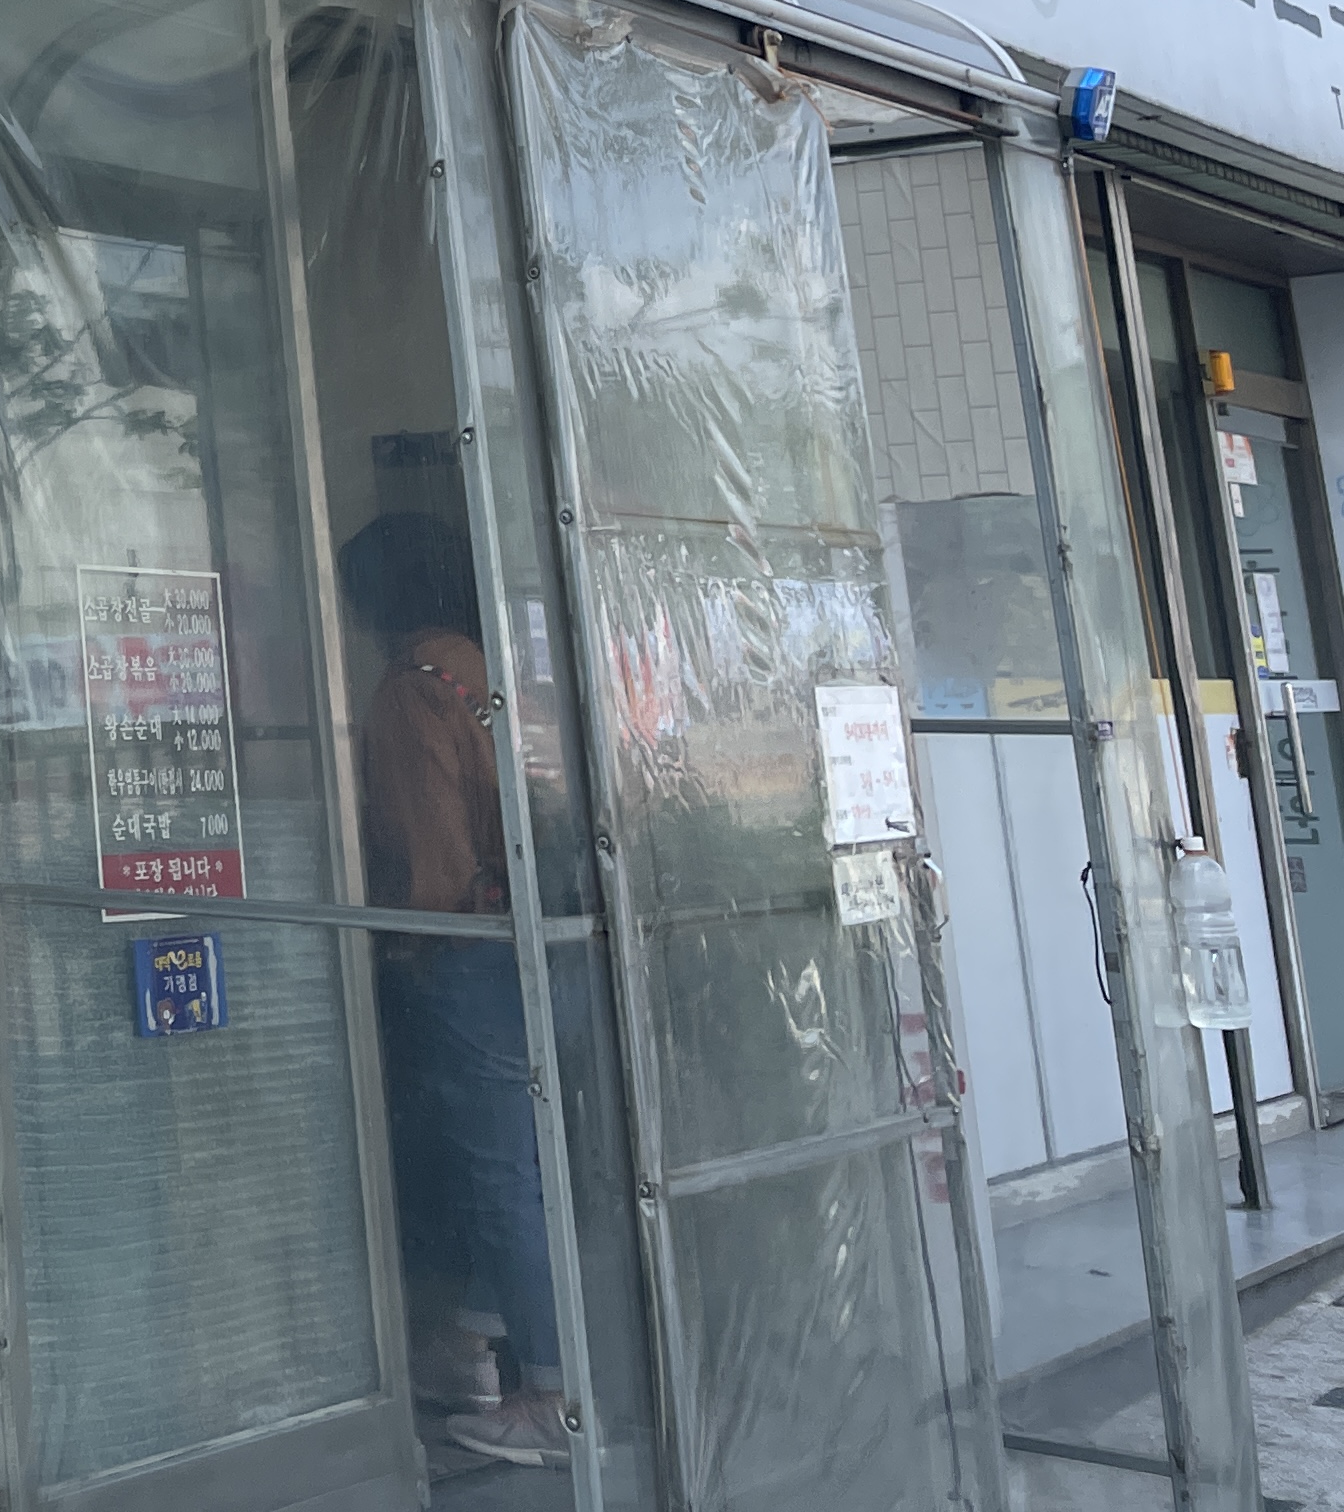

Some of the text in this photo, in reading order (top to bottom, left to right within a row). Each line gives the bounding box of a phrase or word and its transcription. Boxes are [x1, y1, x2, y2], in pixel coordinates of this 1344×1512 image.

[112, 812, 171, 842] 순대국밥
[134, 856, 211, 883] 포장 됩니다
